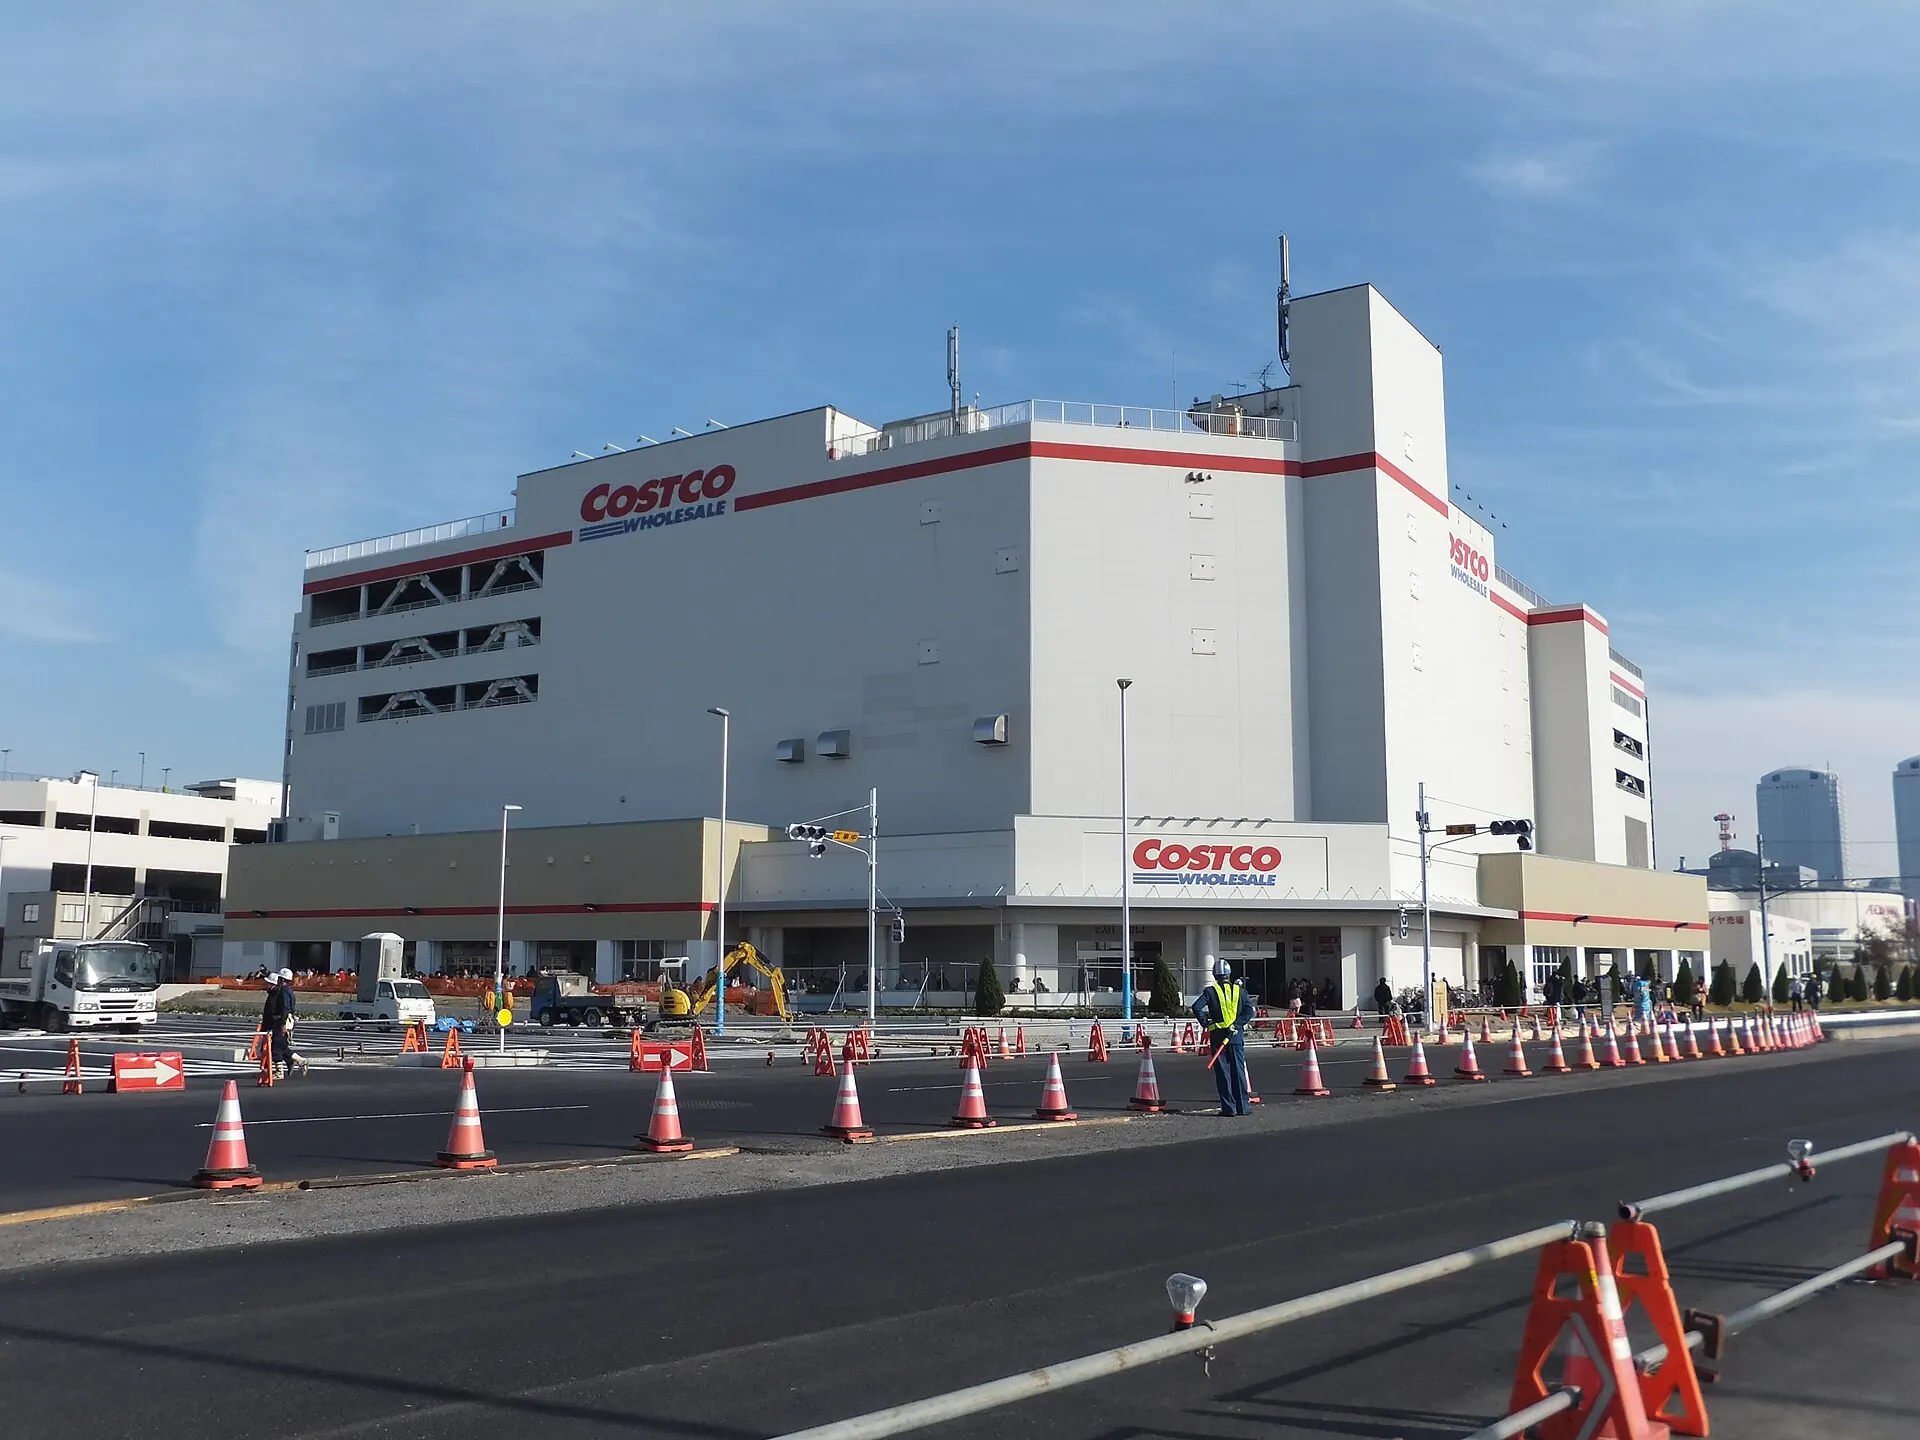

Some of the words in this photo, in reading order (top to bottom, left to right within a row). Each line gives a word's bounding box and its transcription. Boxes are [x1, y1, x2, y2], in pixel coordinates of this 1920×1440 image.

[580, 464, 736, 523] COSTCO
[623, 500, 727, 533] WHOLESALE
[834, 831, 858, 841] 工事中
[1132, 838, 1282, 872] COSTCO
[1177, 873, 1277, 887] WHOLESALE
